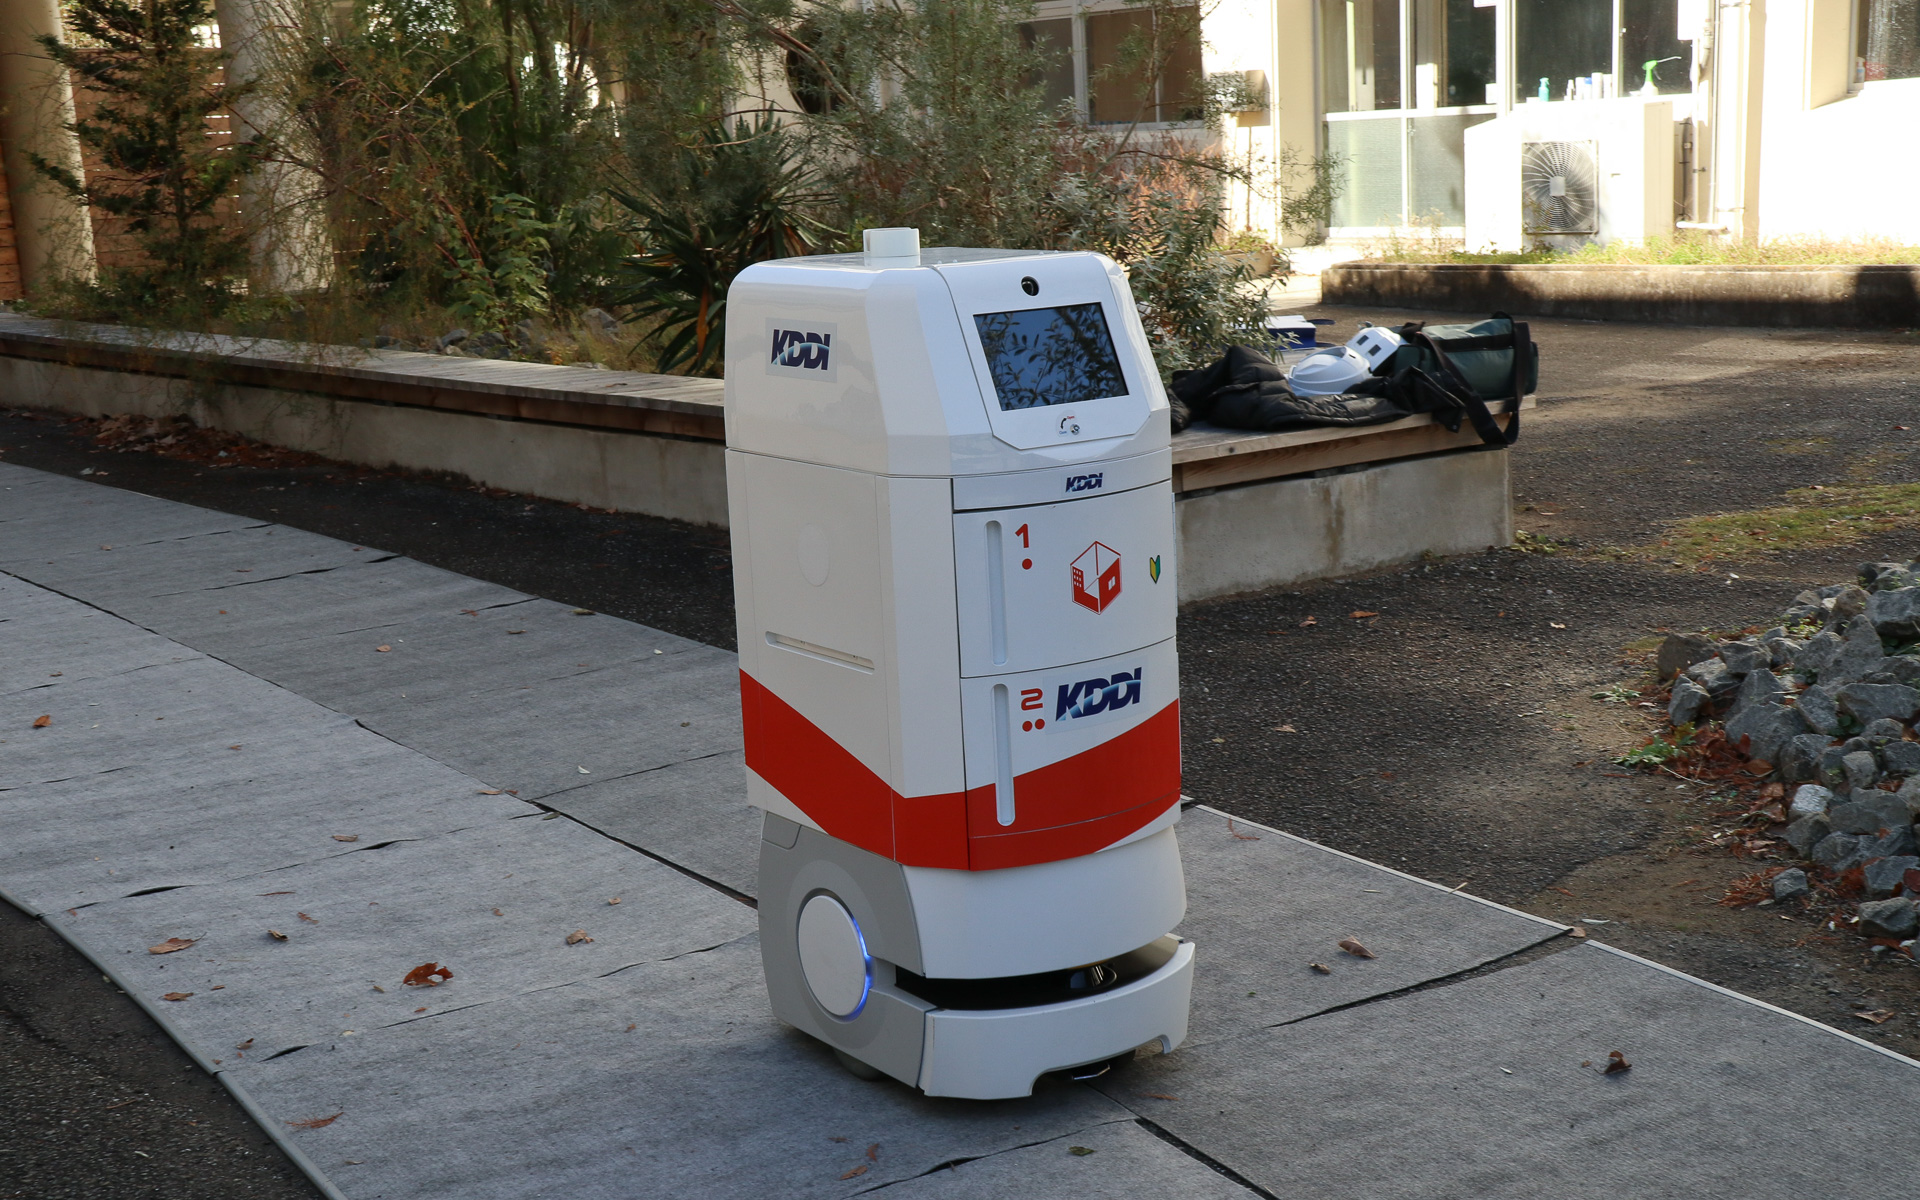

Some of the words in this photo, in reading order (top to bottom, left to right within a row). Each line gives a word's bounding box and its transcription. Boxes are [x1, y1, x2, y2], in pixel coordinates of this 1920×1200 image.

[771, 329, 831, 370] KDDI
[1065, 472, 1104, 492] KDDI
[1015, 523, 1029, 548] 1
[1020, 688, 1044, 711] 2
[1055, 666, 1142, 722] KDDI
